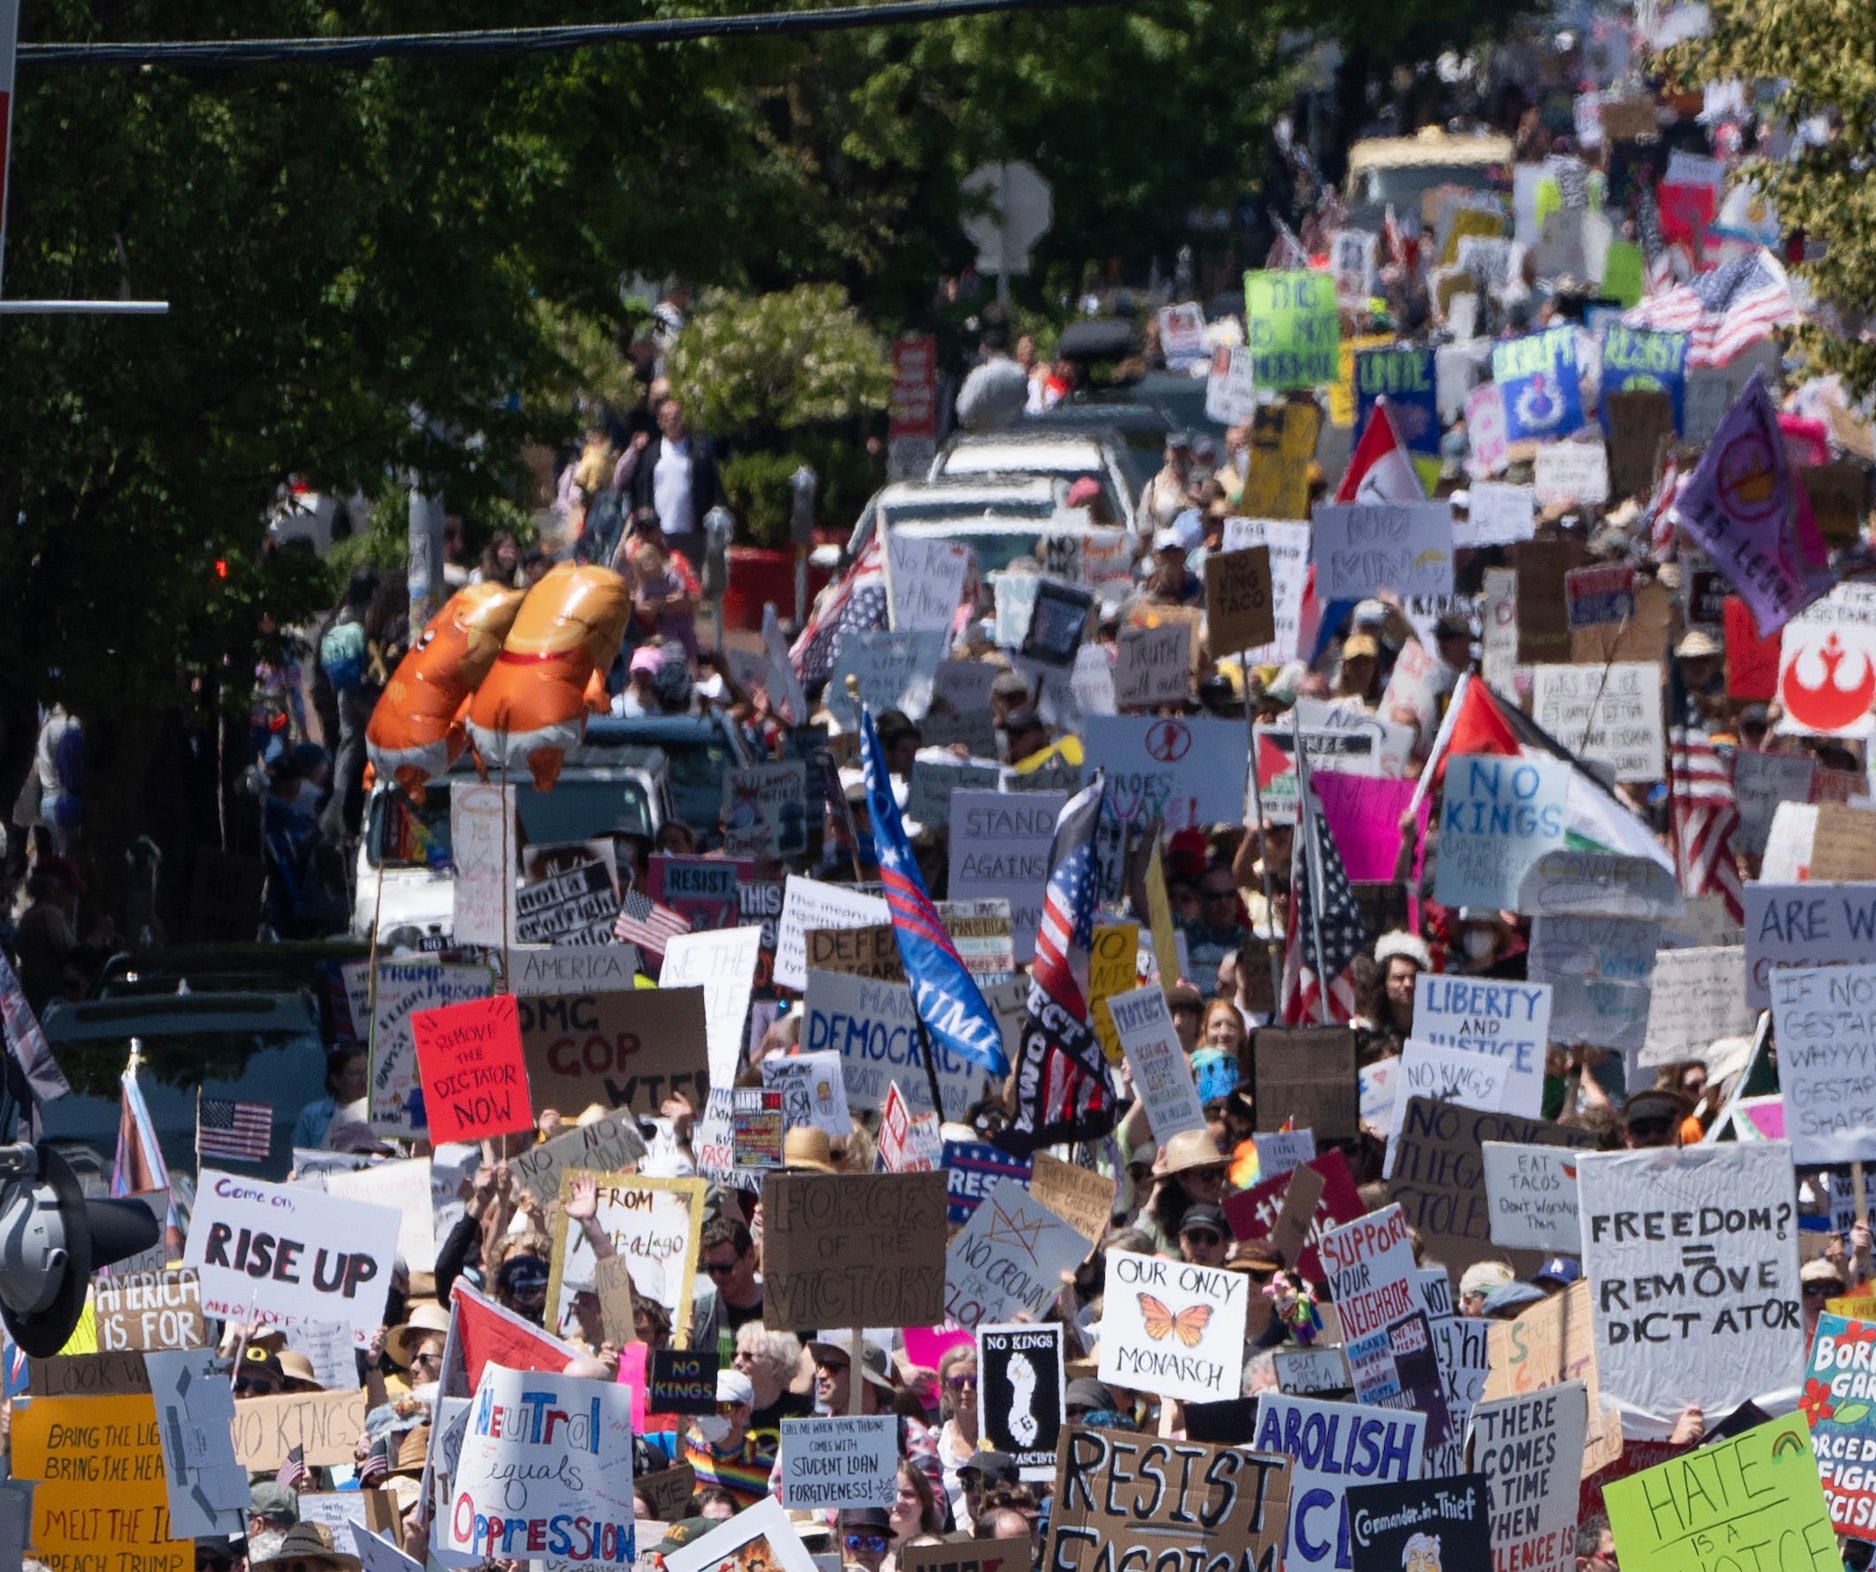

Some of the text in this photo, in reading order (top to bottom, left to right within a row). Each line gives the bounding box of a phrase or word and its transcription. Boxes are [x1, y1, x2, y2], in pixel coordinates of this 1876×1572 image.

[1218, 575, 1257, 589] KING
[1219, 593, 1265, 613] TACO
[1469, 761, 1540, 799] NO
[1446, 804, 1563, 837] KINGS
[669, 869, 732, 893] RESIST
[1760, 903, 1829, 943] ARE
[525, 955, 622, 980] AMERICA
[1427, 982, 1543, 1020] LIBERTY
[1780, 977, 1814, 1003] IF
[435, 1021, 496, 1051] REMOVE
[1460, 1019, 1499, 1035] AND
[456, 1048, 483, 1063] THE
[547, 1033, 641, 1076] GOP
[434, 1066, 516, 1098] DICTATOR
[454, 1096, 512, 1129] NOW
[1518, 1155, 1549, 1173] EAT
[215, 1177, 266, 1206] Come
[1510, 1173, 1560, 1190] TACOS
[1591, 1203, 1792, 1241] FREEDOM?
[204, 1222, 378, 1298] RISE UP
[1323, 1222, 1408, 1271] SUPPORT
[96, 1269, 200, 1313] AMERICA
[1116, 1258, 1241, 1302] OUR ONLY
[1330, 1266, 1370, 1294] YOUR
[1601, 1259, 1779, 1312] REMOVE
[1338, 1279, 1415, 1341] NEIGHBOR
[105, 1314, 200, 1349] IS FOR
[987, 1334, 1054, 1349] NO KINGS
[1117, 1346, 1224, 1391] MONARCH
[1474, 1398, 1557, 1441] THERE
[46, 1424, 134, 1449] BRING THE
[1257, 1406, 1416, 1480] ABOLISH
[44, 1456, 131, 1481] BRING THE
[791, 1455, 878, 1475] STUDENT LOAN
[1482, 1443, 1556, 1478] COMES
[486, 1457, 583, 1511] equals
[790, 1478, 872, 1499] FORGIVENESS!
[1063, 1430, 1286, 1533] RESIST
[1641, 1434, 1776, 1540] HATE
[44, 1509, 143, 1542] MELT THE
[1692, 1528, 1740, 1557] IS A
